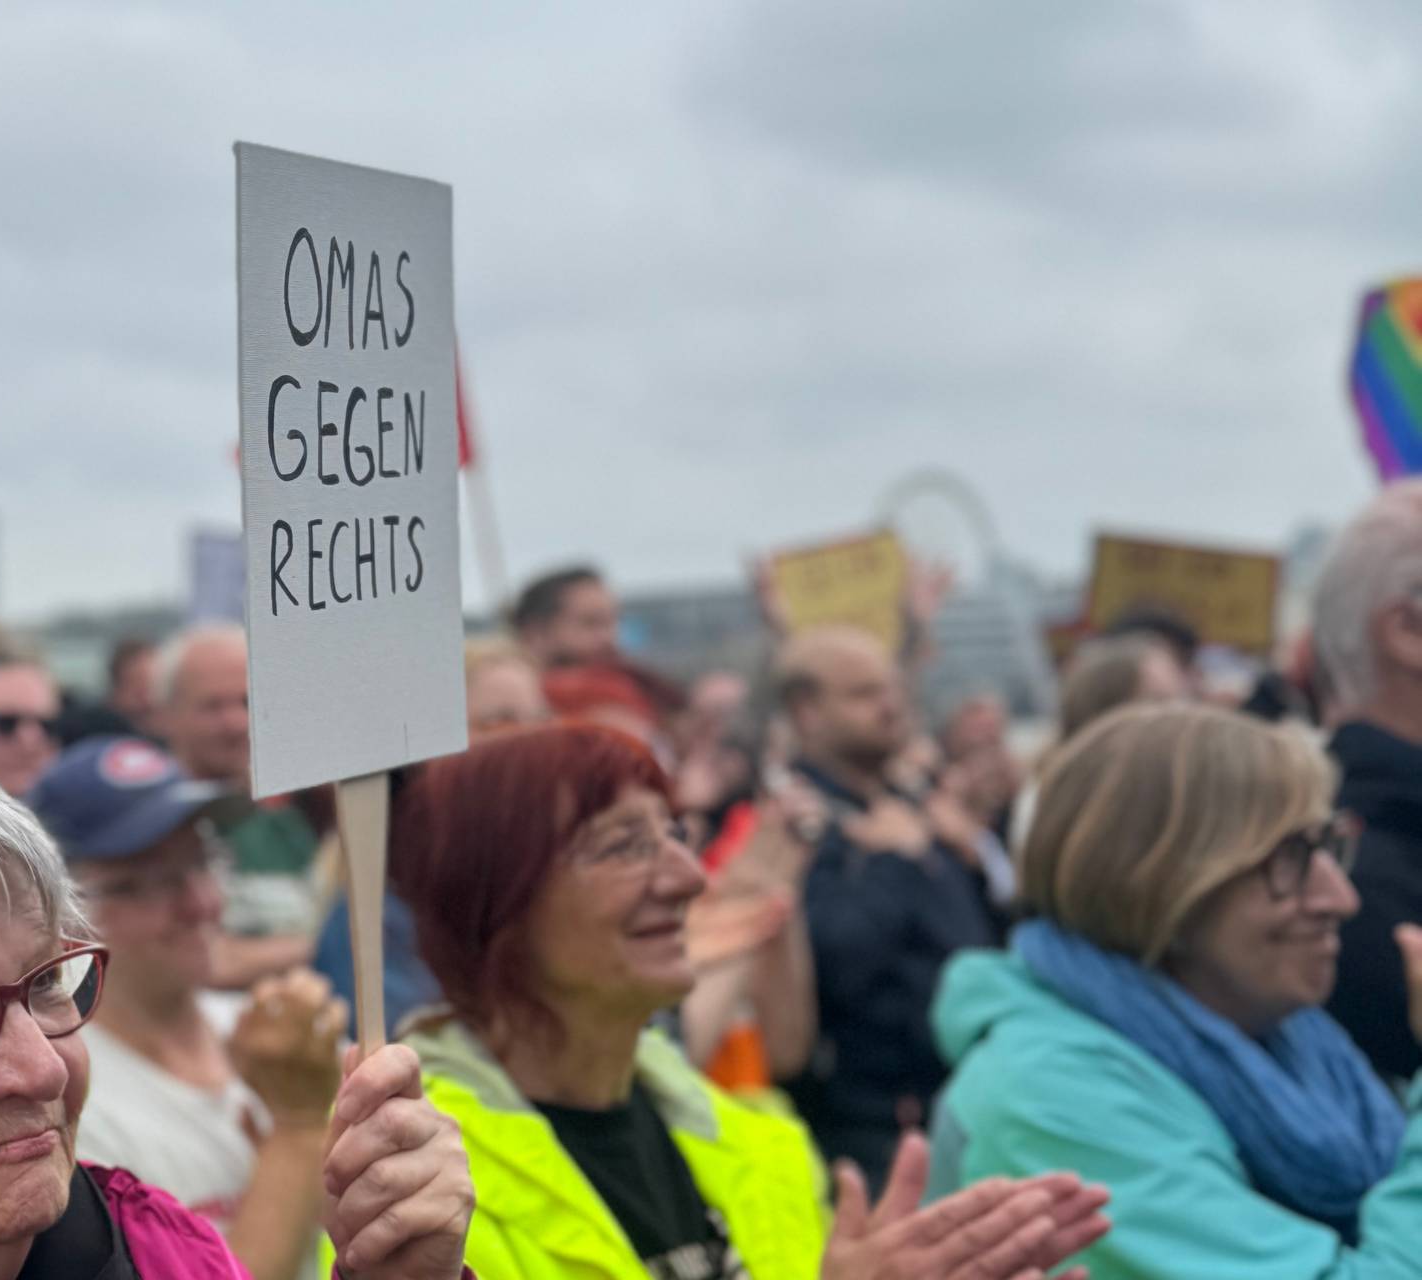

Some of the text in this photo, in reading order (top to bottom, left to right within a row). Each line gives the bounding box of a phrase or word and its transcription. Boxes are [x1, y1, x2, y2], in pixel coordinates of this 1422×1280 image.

[283, 226, 416, 351] OMAS
[266, 373, 426, 488] GEGEN
[269, 514, 425, 618] RECHTS
